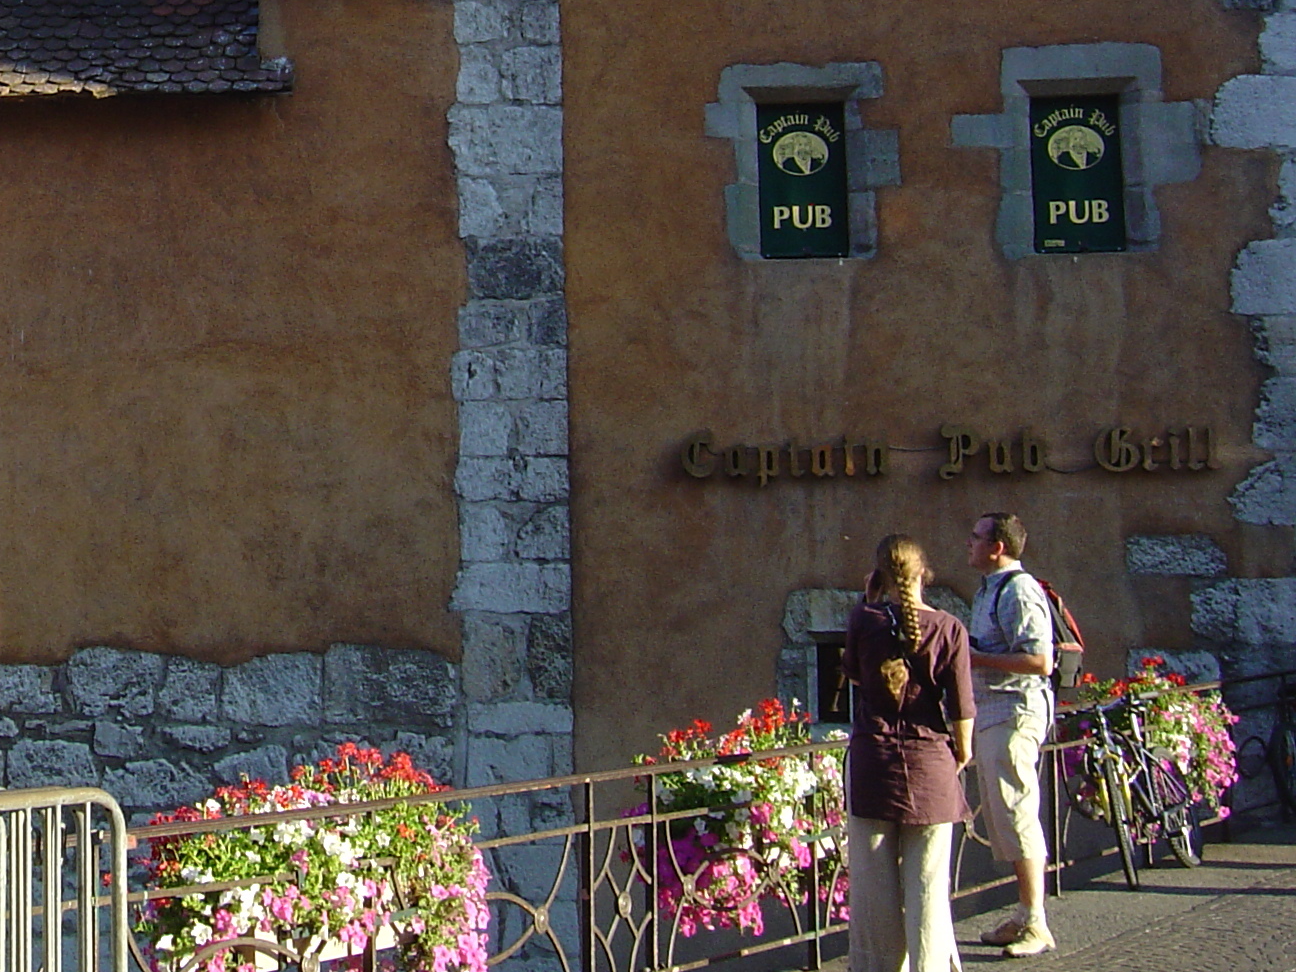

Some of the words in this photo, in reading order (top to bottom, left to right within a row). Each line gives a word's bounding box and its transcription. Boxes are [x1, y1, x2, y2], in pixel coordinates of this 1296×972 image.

[759, 112, 809, 144] Captain
[813, 115, 840, 143] Pub
[1033, 106, 1084, 138] Captain
[1088, 109, 1115, 136] Pub
[773, 205, 832, 229] PUB
[1049, 200, 1110, 225] PUB
[681, 429, 890, 488] Captain
[939, 425, 1046, 479] Pub
[1094, 426, 1222, 472] Grill
